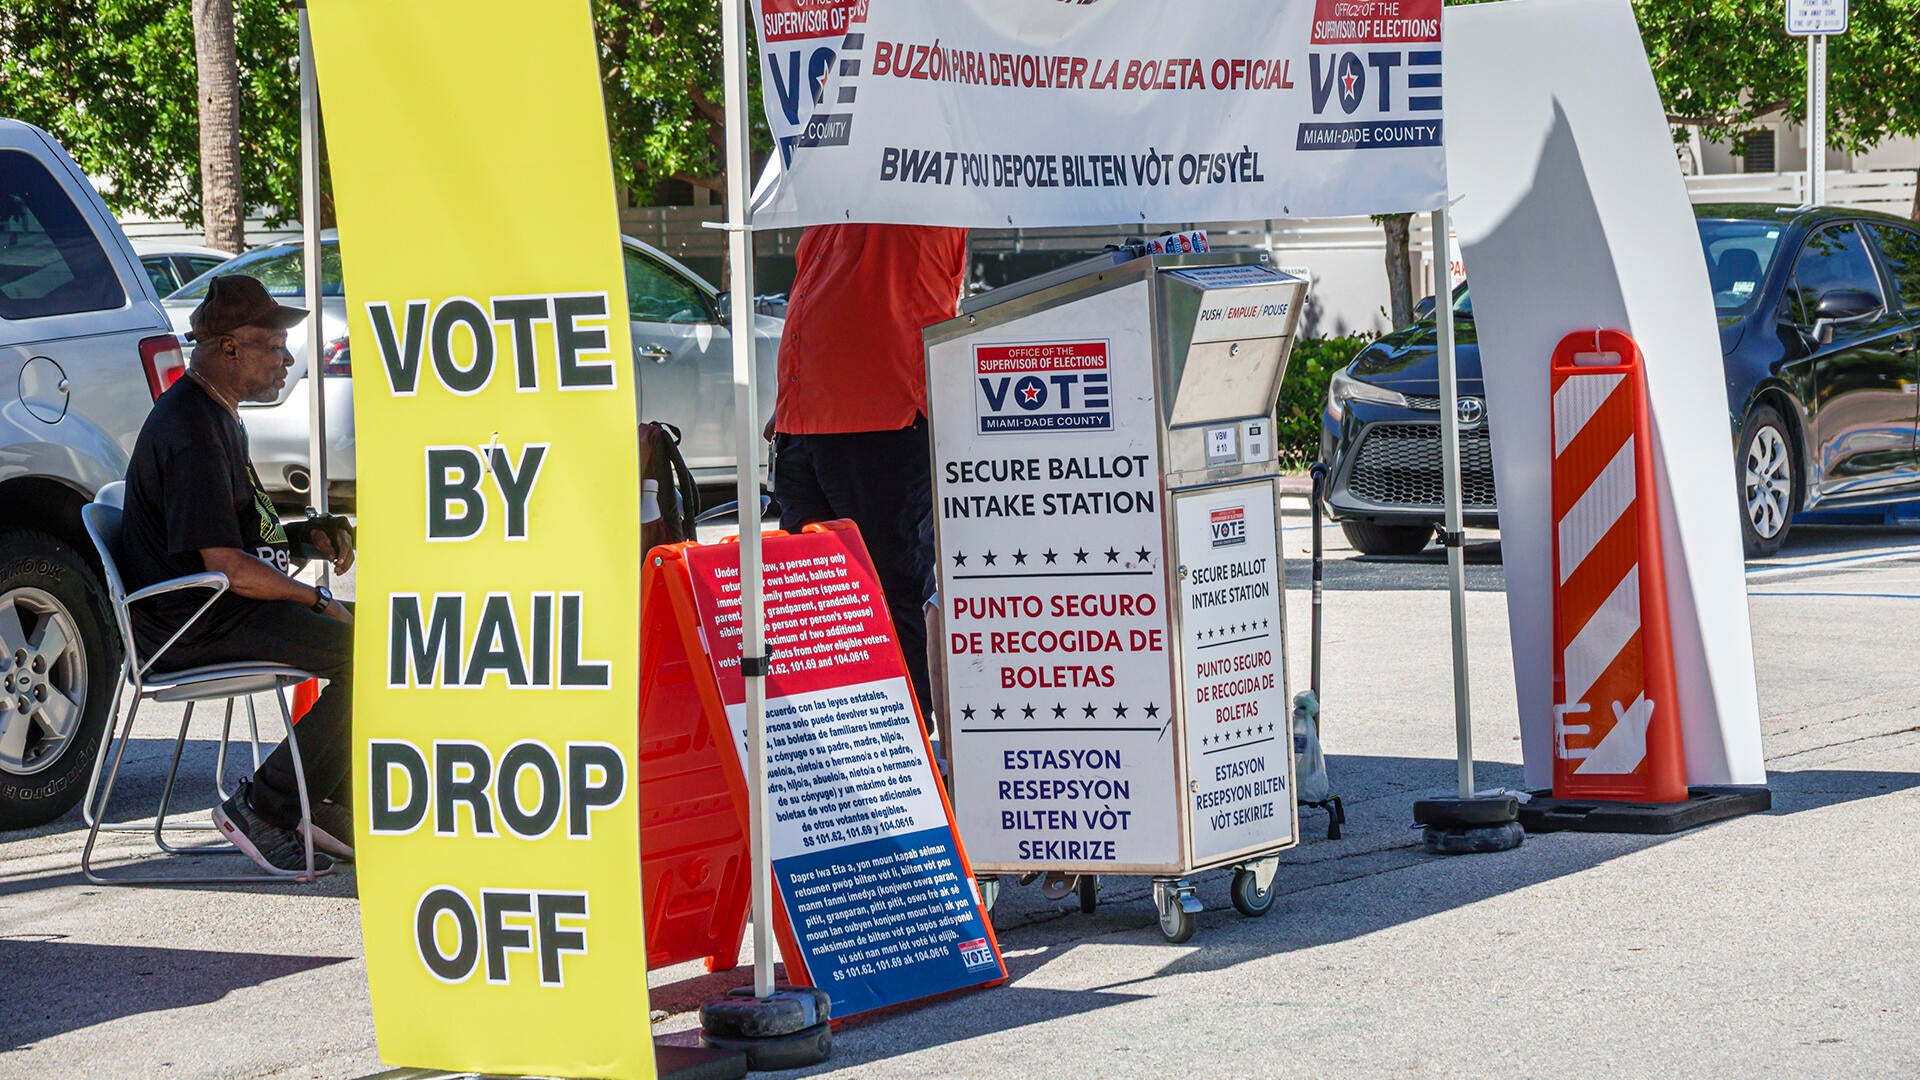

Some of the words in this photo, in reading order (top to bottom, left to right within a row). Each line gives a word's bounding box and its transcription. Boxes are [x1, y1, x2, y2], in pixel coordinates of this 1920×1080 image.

[765, 8, 829, 36] SUPERVISOR
[831, 7, 846, 30] OF
[1334, 2, 1360, 17] OFFICE
[1361, 2, 1376, 16] OF
[1377, 2, 1399, 16] THE
[1314, 20, 1357, 39] SUPERVISOR
[1357, 20, 1371, 38] OF
[1373, 19, 1438, 38] ELECTIONS
[872, 39, 951, 82] BUZÓN
[951, 51, 987, 86] PARA
[989, 52, 1088, 89] DEVOLVER
[1089, 58, 1119, 90] LA
[1122, 58, 1205, 90] BOLETA
[1211, 58, 1294, 90] OFICIAL
[1308, 51, 1442, 115] VOTE
[808, 121, 847, 139] COUNTY
[1303, 128, 1371, 145] MIAMI-DADE
[1373, 126, 1437, 142] COUNTY
[880, 146, 959, 186] BWAT
[960, 153, 989, 187] POU
[993, 154, 1059, 188] DEPOZE
[1064, 154, 1127, 188] BILTEN
[1134, 147, 1174, 187] VÒT
[1178, 144, 1265, 185] OFISYÈL
[1200, 309, 1222, 321] PUSH
[1227, 306, 1258, 319] EMPUJE
[1263, 304, 1288, 316] POUSE
[367, 294, 616, 395] VOTE
[1008, 347, 1041, 359] OFFICE
[1041, 348, 1055, 358] OF
[1056, 346, 1075, 356] THE
[980, 357, 1038, 371] SUPERVISOR
[1039, 357, 1052, 368] OF
[1053, 354, 1104, 368] ELECTIONS
[979, 373, 1109, 411] VOTE
[986, 417, 1054, 429] MIAMI-DADE
[1056, 415, 1104, 426] COUNTY
[945, 458, 1041, 484] SECURE
[1048, 455, 1149, 479] BALLOT
[426, 445, 549, 541] BY
[944, 494, 1036, 519] INTAKE
[1042, 490, 1154, 515] STATION
[1211, 520, 1245, 539] VOTE
[714, 566, 739, 579] Under
[779, 562, 785, 570] a
[785, 558, 813, 572] person
[812, 556, 829, 567] may
[829, 552, 846, 565] only
[1192, 565, 1228, 585] SECURE
[1230, 558, 1266, 579] BALLOT
[721, 582, 741, 593] retur
[767, 577, 784, 587] own
[783, 572, 810, 584] ballot,
[808, 569, 836, 581] ballots
[835, 567, 847, 577] for
[767, 600, 817, 617] grandparent,
[817, 593, 861, 611] grandchild,
[861, 593, 870, 603] or
[953, 595, 1043, 619] PUNTO
[1050, 593, 1157, 618] SEGURO
[1191, 588, 1227, 610] INTAKE
[1228, 581, 1269, 603] STATION
[389, 593, 611, 688] MAIL
[951, 631, 984, 654] DE
[991, 630, 1123, 654] RECOGIDA
[1129, 629, 1163, 652] DE
[790, 658, 817, 672] 101.69
[817, 655, 833, 668] and
[833, 650, 870, 665] 104.0616
[1197, 658, 1231, 679] PUNTO
[1233, 650, 1272, 672] SEGURO
[1001, 665, 1115, 689] BOLETAS
[1197, 688, 1209, 704] DE
[1211, 676, 1261, 700] RECOGIDA
[1262, 673, 1275, 690] DE
[798, 703, 814, 713] con
[813, 700, 827, 710] las
[826, 697, 849, 709] leyes
[849, 690, 888, 704] estatales,
[1216, 700, 1259, 724] BOLETAS
[1003, 749, 1121, 770] ESTASYON
[1215, 756, 1265, 782] ESTASYON
[369, 739, 626, 839] DROP
[777, 796, 789, 807] de
[789, 796, 800, 805] su
[800, 787, 837, 803] cónyuge)
[837, 787, 843, 798] y
[844, 785, 857, 794] un
[855, 779, 887, 792] máximo
[887, 776, 898, 786] de
[898, 774, 913, 784] dos
[999, 779, 1130, 800] RESEPSYON
[1196, 783, 1252, 810] RESEPSYON
[1254, 775, 1286, 797] BILTEN
[775, 809, 807, 822] boletas
[807, 806, 818, 816] de
[818, 803, 837, 814] voto
[838, 801, 851, 813] por
[852, 796, 878, 808] correo
[879, 786, 922, 803] adicionales
[1001, 810, 1077, 830] BILTEN
[1083, 804, 1131, 830] VÒT
[1210, 809, 1231, 831] VÒT
[1233, 802, 1274, 825] SEKIRIZE
[802, 836, 815, 848] SS
[815, 830, 846, 845] 101.62,
[845, 824, 873, 839] 101.69
[872, 824, 879, 836] y
[879, 816, 915, 832] 104.0616
[1018, 840, 1116, 860] SEKIRIZE
[790, 872, 815, 884] Dapre
[831, 865, 846, 875] Eta
[847, 864, 856, 872] a,
[856, 860, 871, 872] yon
[872, 856, 894, 866] moun
[893, 848, 918, 862] kapab
[918, 845, 946, 857] sèlman
[798, 901, 824, 913] manm
[823, 893, 847, 907] fanmi
[847, 889, 877, 902] imedya
[877, 881, 913, 897] (konjwen
[913, 877, 934, 888] oswa
[933, 872, 958, 886] paran,
[415, 886, 588, 986] OFF
[833, 970, 845, 981] SS
[846, 963, 876, 978] 101.62,
[876, 956, 902, 971] 101.69
[903, 954, 914, 965] ak
[914, 945, 949, 962] 104.0616
[962, 948, 992, 966] VOTE
